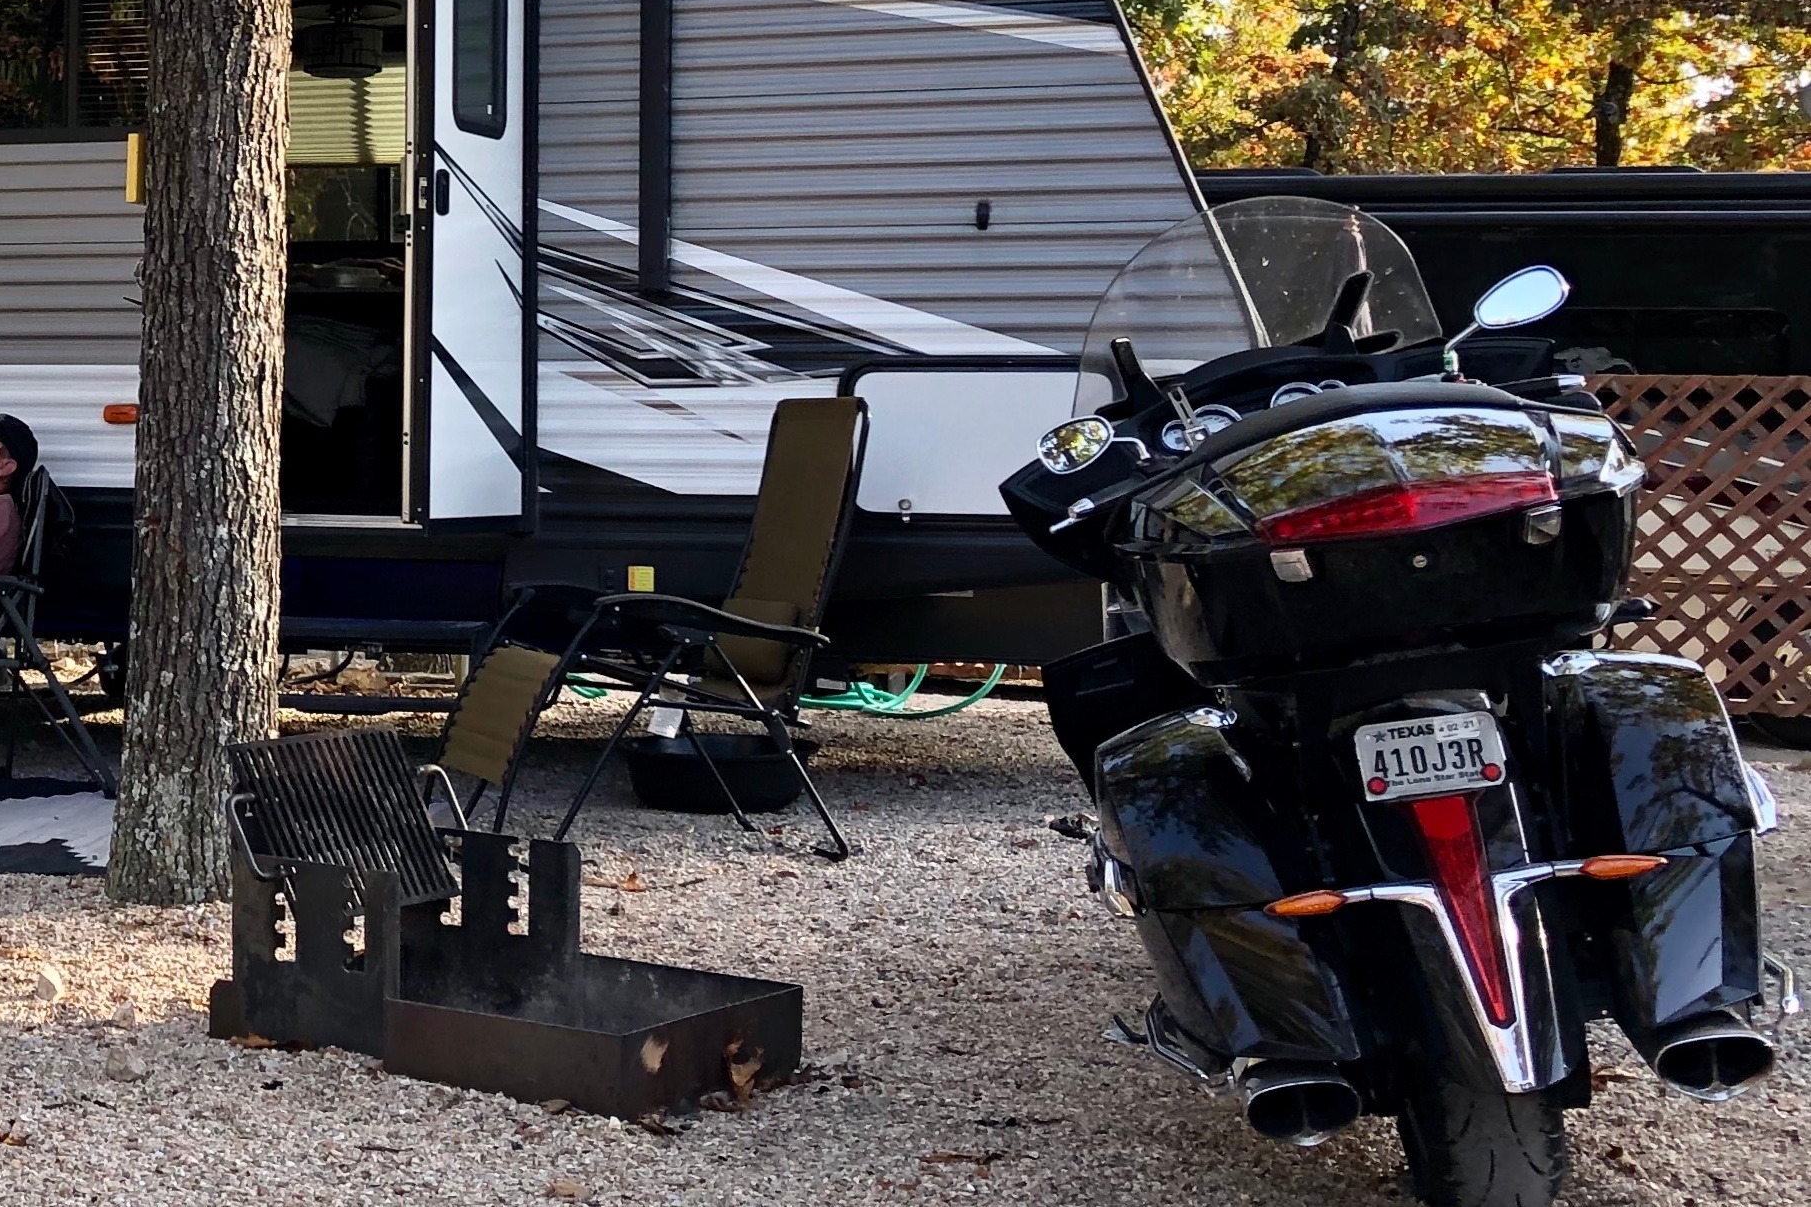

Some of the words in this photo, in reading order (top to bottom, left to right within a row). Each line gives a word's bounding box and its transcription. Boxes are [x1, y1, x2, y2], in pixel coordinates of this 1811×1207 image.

[1387, 723, 1435, 740] TEXAS
[1447, 723, 1459, 732] 02
[1464, 719, 1475, 729] 21
[1373, 738, 1486, 779] 410J3R
[1407, 776, 1432, 785] Lone
[1434, 773, 1456, 781] Star
[1458, 770, 1481, 779] Stat
